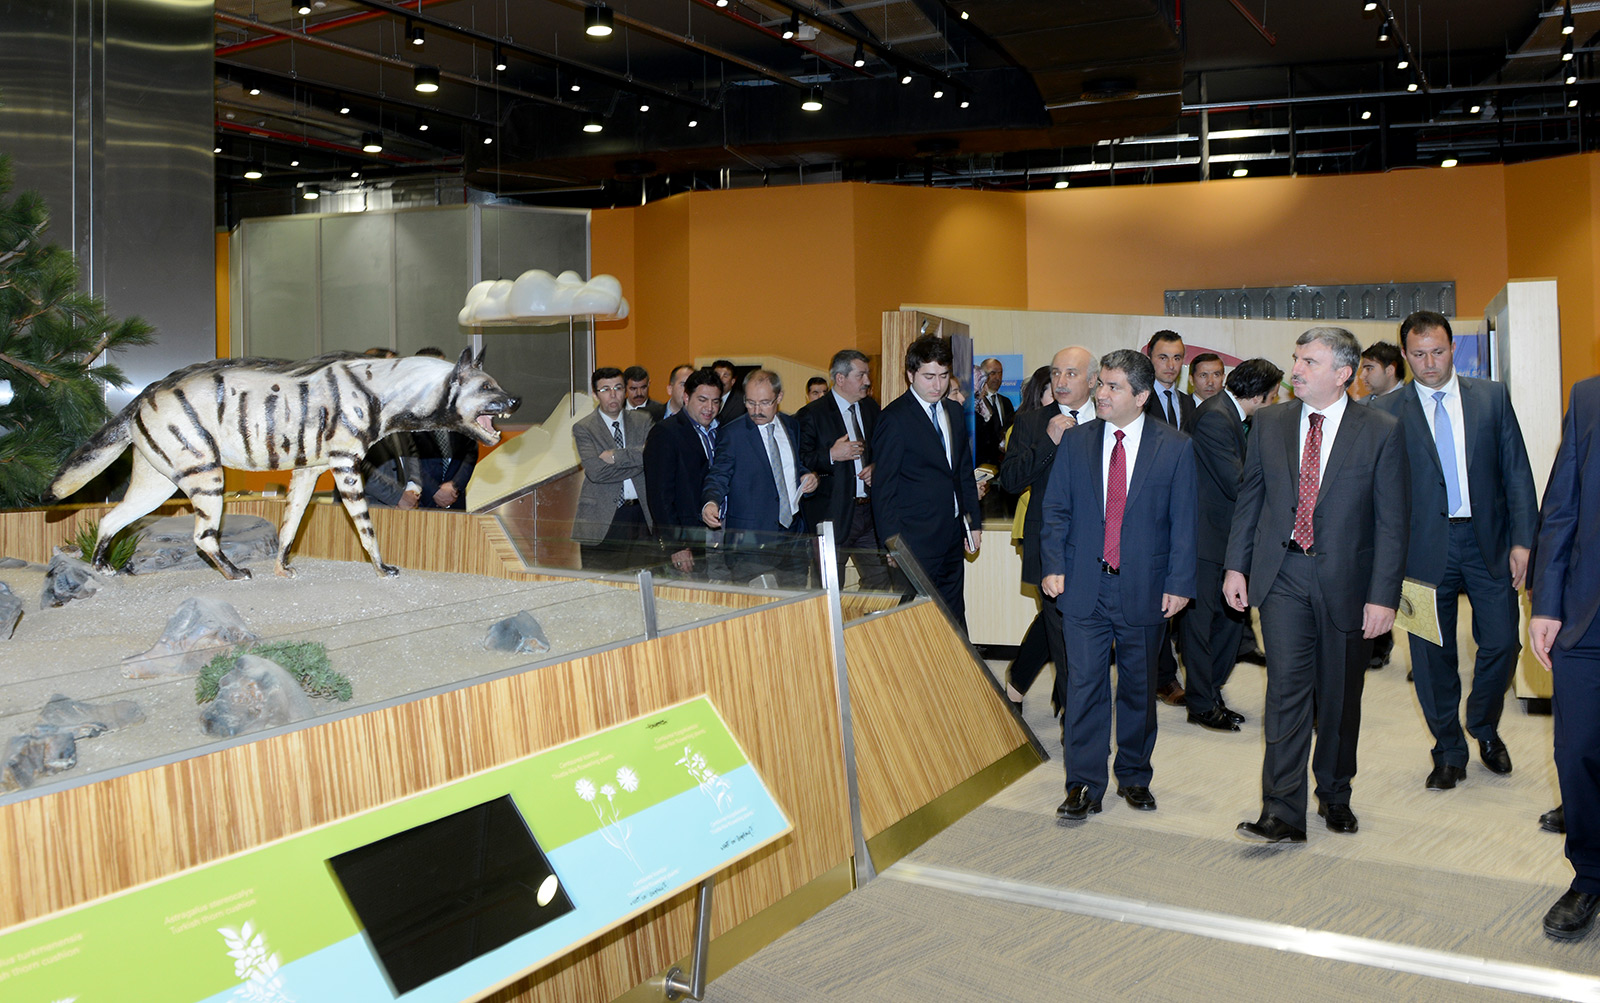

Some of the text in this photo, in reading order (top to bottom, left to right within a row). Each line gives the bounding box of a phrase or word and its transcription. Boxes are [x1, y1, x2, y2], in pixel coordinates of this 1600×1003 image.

[169, 899, 257, 935] Turkish thorn cushion
[11, 960, 40, 977] thorn
[41, 946, 80, 967] cushion
